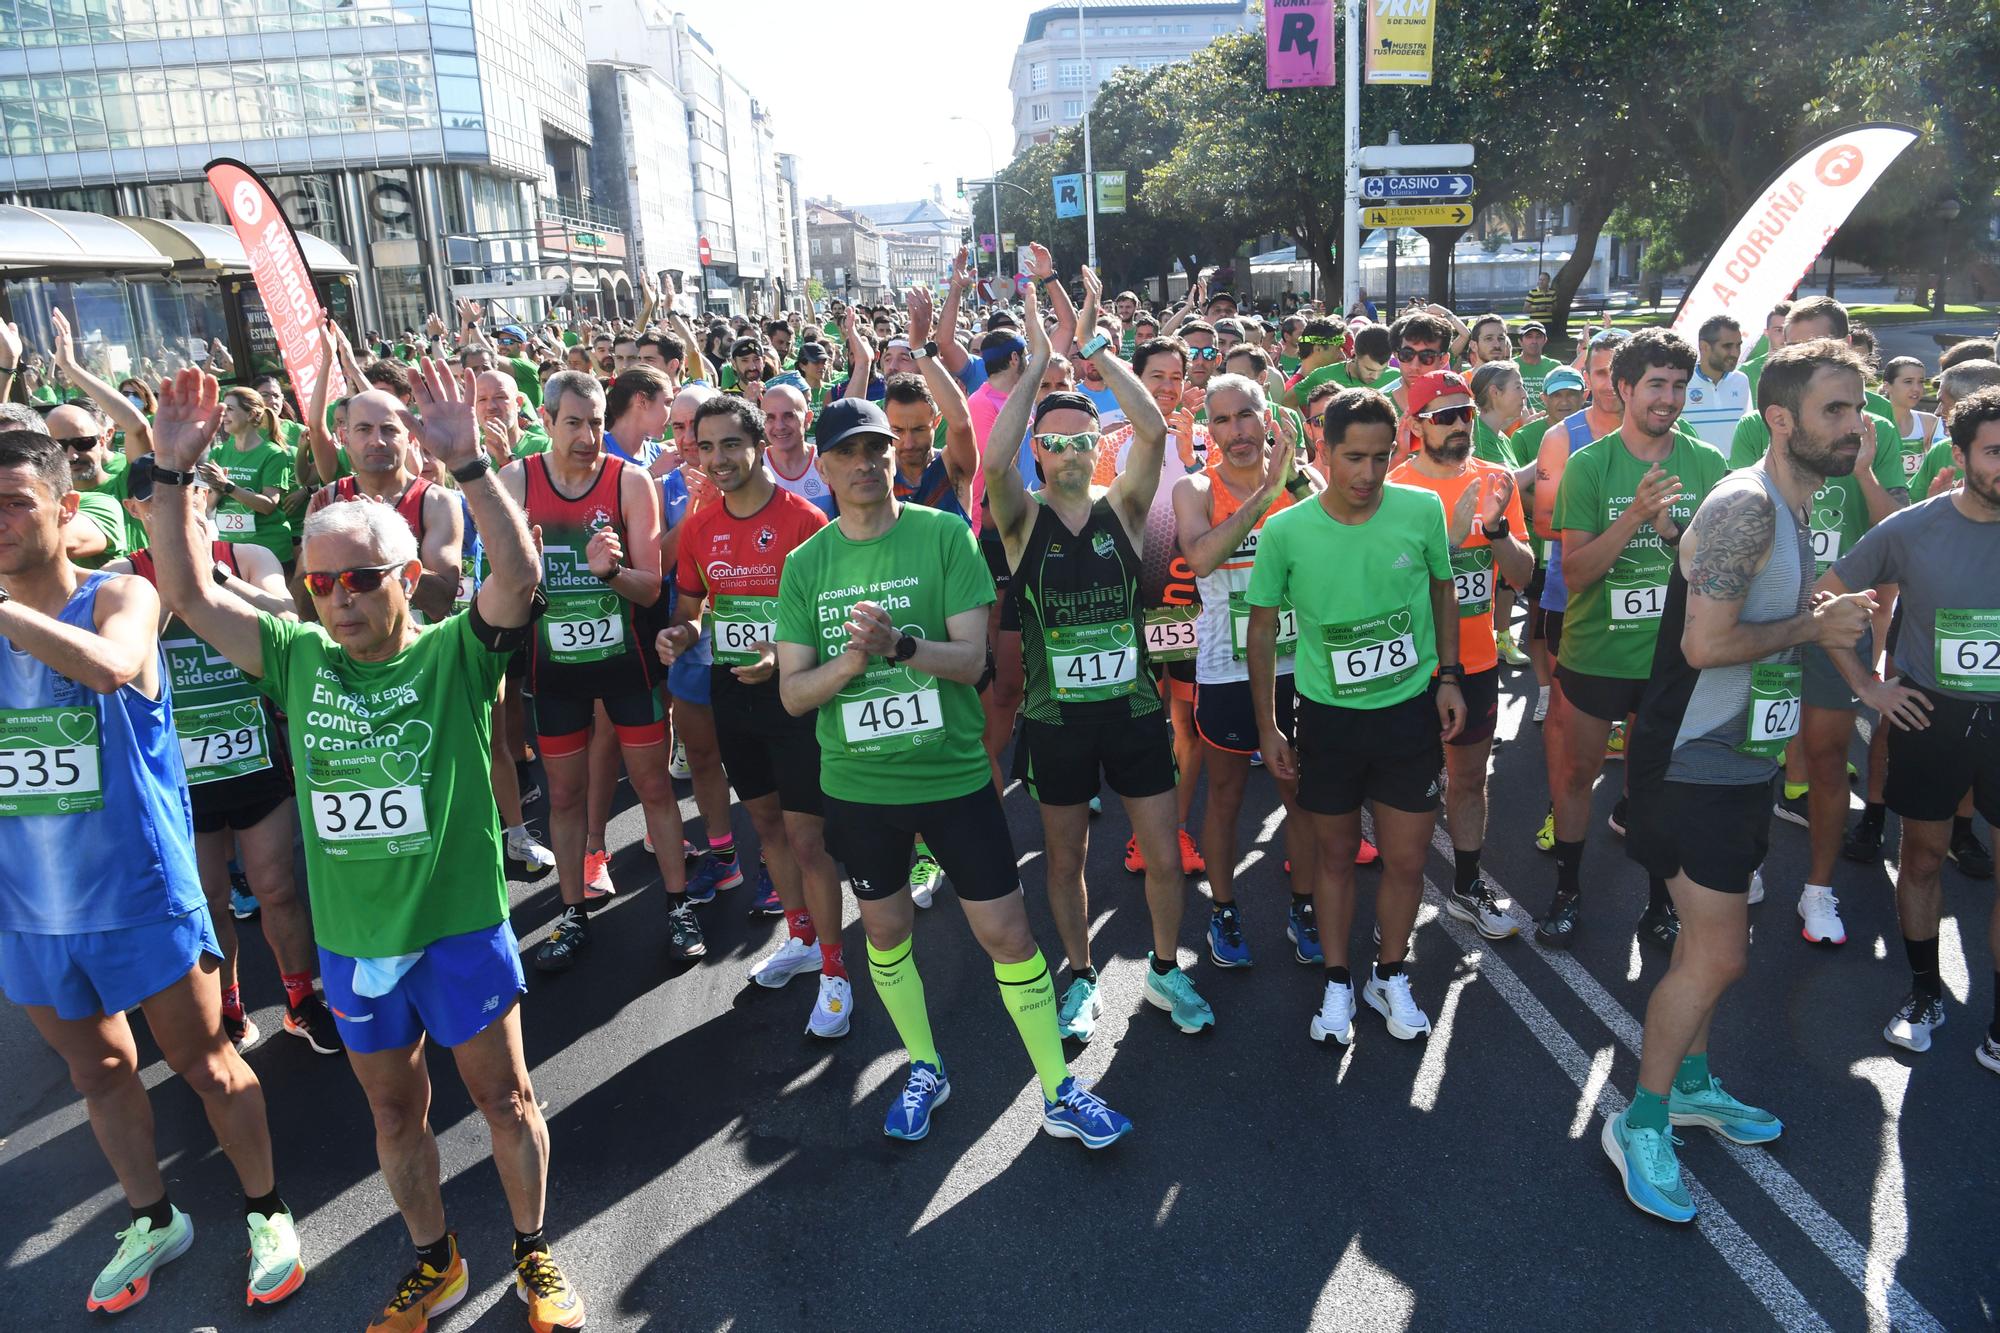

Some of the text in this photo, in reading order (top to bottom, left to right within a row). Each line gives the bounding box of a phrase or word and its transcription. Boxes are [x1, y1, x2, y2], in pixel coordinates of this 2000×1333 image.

[1278, 13, 1319, 70] R
[1392, 42, 1427, 50] MUESTRA
[1373, 48, 1426, 56] TUS PODERES
[1389, 177, 1440, 189] CASINO
[1391, 207, 1447, 217] EUROSTARS
[1712, 180, 1808, 308] A CORUÑA
[247, 312, 269, 323] WHIS
[227, 473, 252, 481] archa
[1608, 497, 1615, 505] A
[225, 514, 244, 530] 28
[548, 557, 570, 573] by
[720, 578, 778, 589] clínica ocular
[870, 583, 880, 593] IX
[880, 576, 919, 591] EDICIÓN
[1455, 572, 1486, 599] 38
[1045, 582, 1124, 608] Running
[1625, 588, 1661, 614] 61
[818, 605, 840, 623] En
[560, 619, 615, 647] 392
[1085, 627, 1109, 636] marcha
[1362, 619, 1386, 630] marcha
[726, 623, 770, 648] 681
[1150, 622, 1195, 647] 453
[827, 645, 838, 656] o
[1347, 640, 1407, 677] 678
[171, 653, 198, 672] by
[1067, 651, 1126, 683] 417
[176, 667, 241, 687] sidecar
[866, 667, 903, 679] en marcha
[316, 666, 323, 678] A
[371, 692, 382, 704] IX
[313, 683, 334, 706] En
[7, 714, 54, 724] en marcha
[208, 710, 231, 718] marcha
[859, 693, 929, 732] 461
[1765, 699, 1800, 734] 627
[8, 726, 38, 734] cancro
[306, 709, 373, 735] contra
[191, 728, 253, 763] 739
[304, 733, 316, 749] o
[0, 748, 80, 788] 535
[342, 755, 376, 766] marcha
[331, 767, 361, 776] cancro
[323, 789, 408, 833] 326
